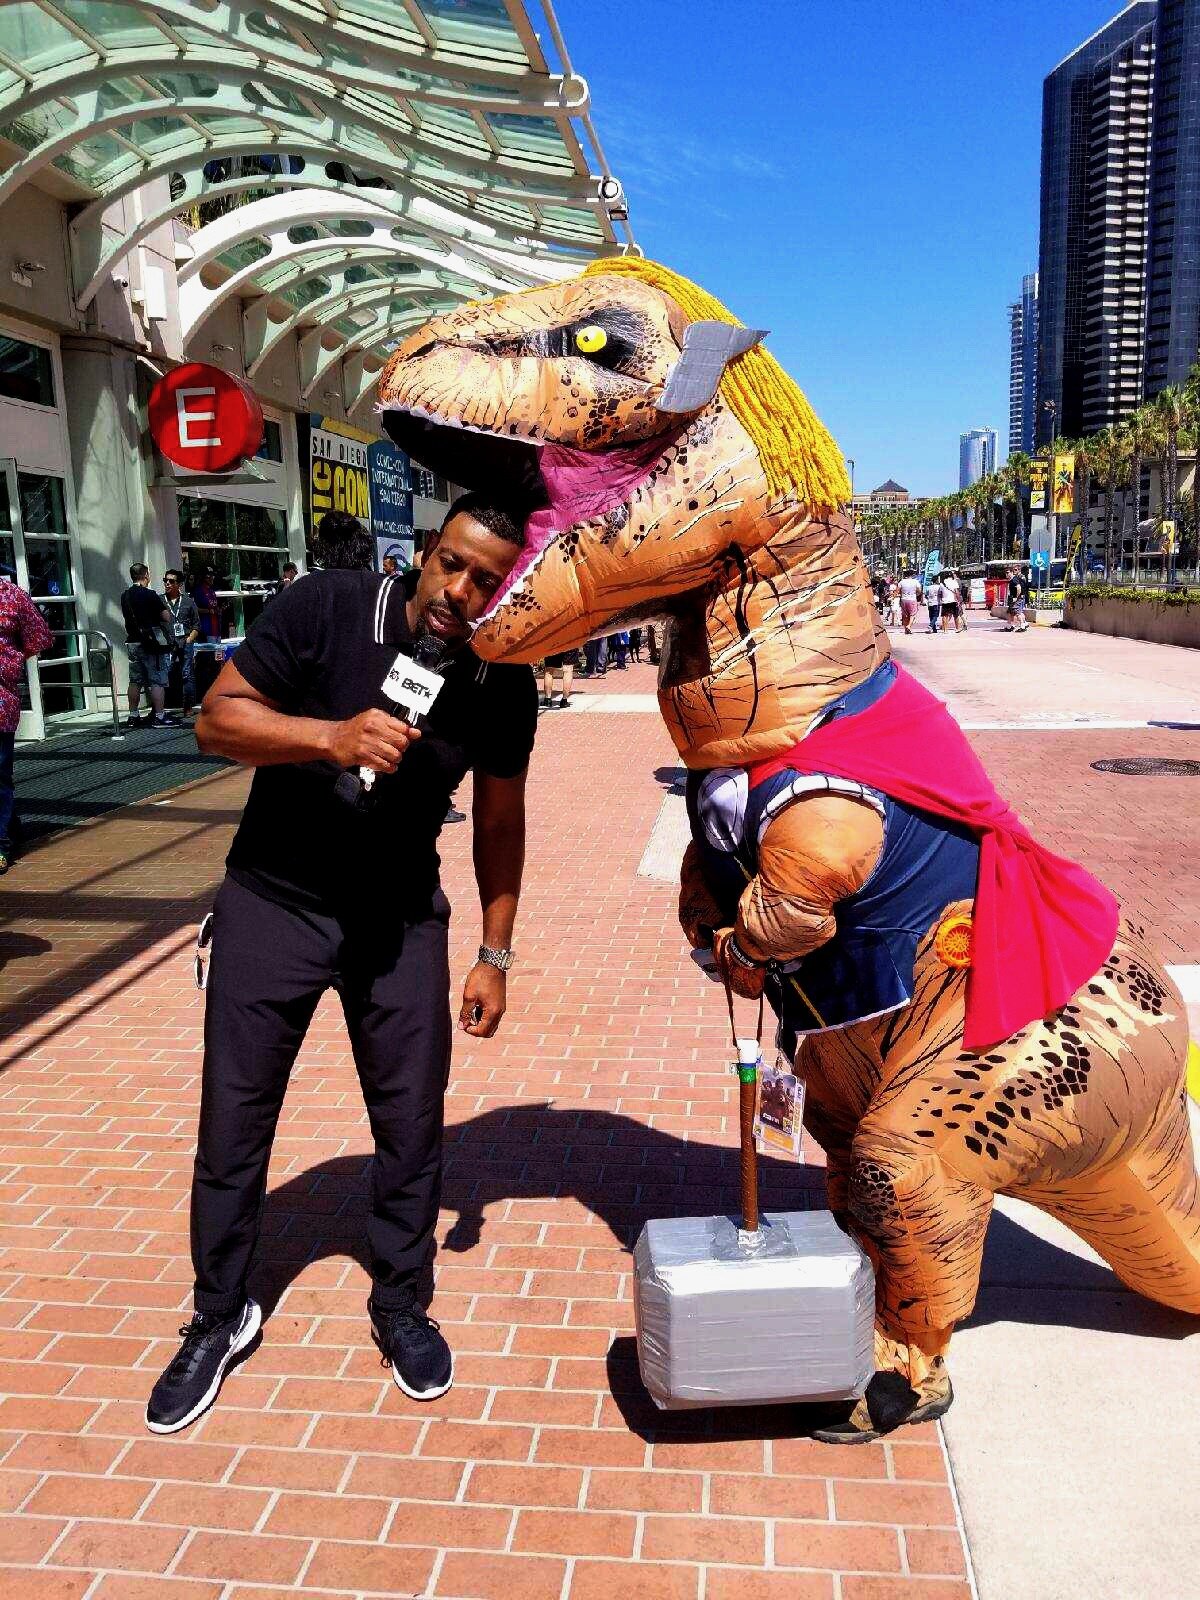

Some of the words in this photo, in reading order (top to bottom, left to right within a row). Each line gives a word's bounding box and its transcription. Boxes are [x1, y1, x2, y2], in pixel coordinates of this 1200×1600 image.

[176, 387, 221, 447] E
[312, 435, 332, 459] SAN
[339, 443, 367, 468] DIEGO
[333, 465, 370, 519] CON
